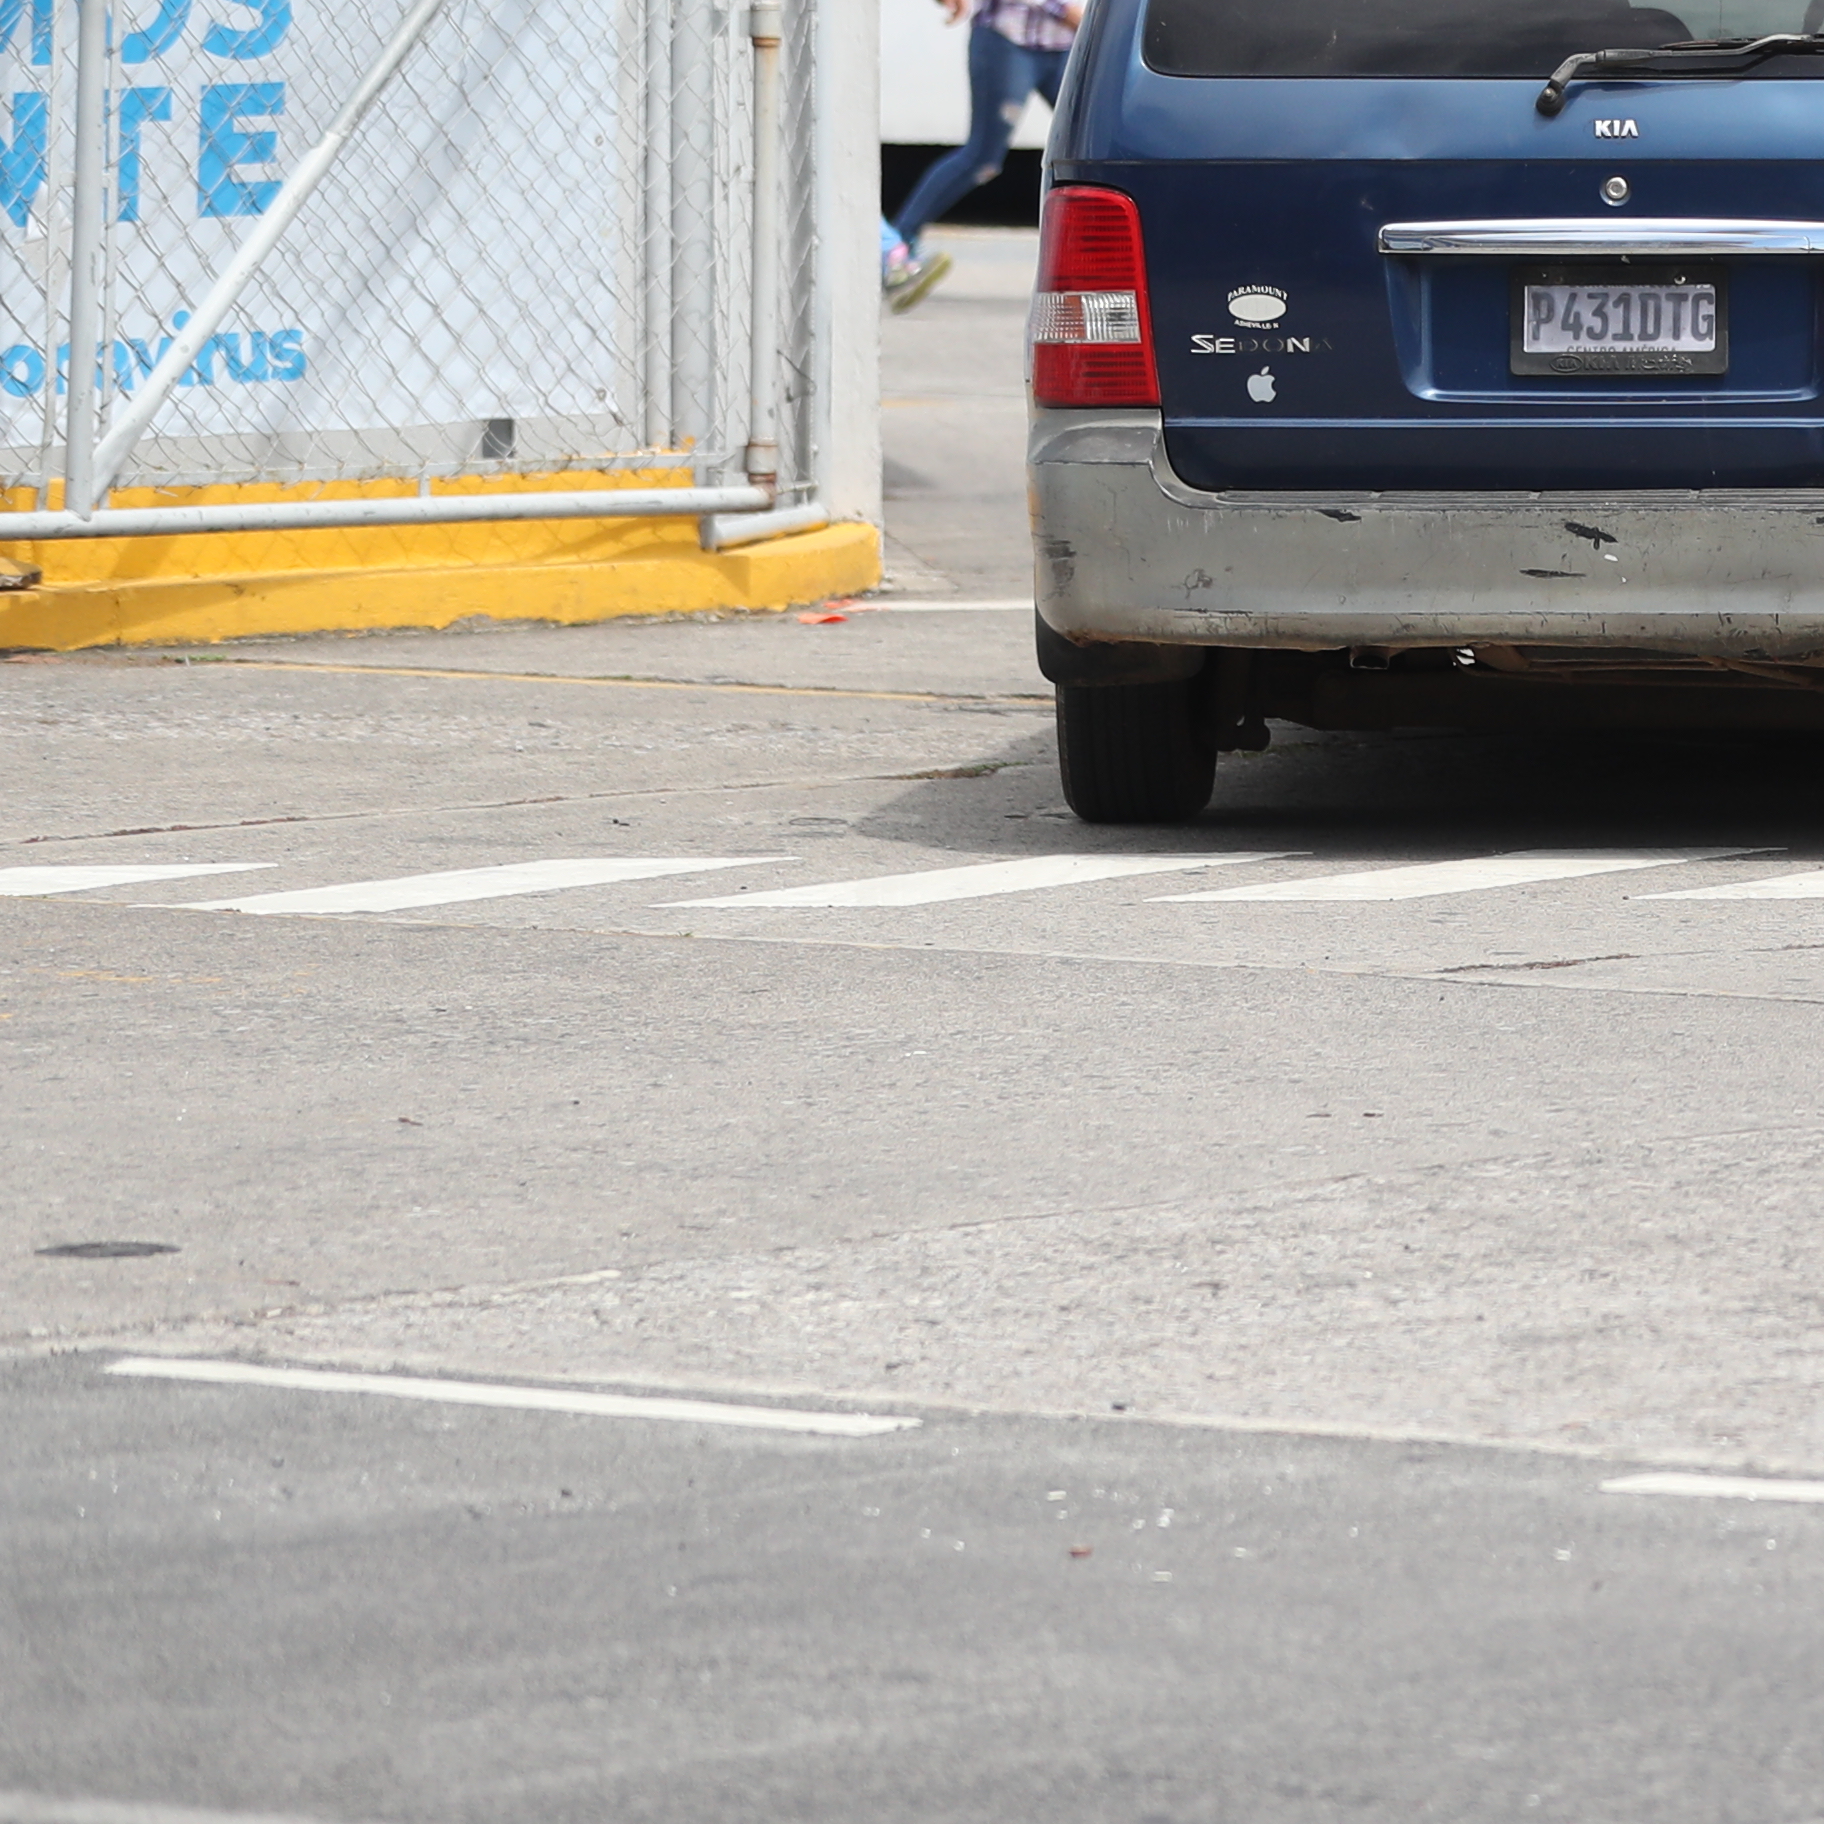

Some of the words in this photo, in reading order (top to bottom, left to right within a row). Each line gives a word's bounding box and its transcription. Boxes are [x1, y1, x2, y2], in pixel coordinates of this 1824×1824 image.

[1595, 119, 1639, 137] KIA
[1227, 285, 1288, 302] PARAMOUNT
[1529, 291, 1715, 342] P431DTG
